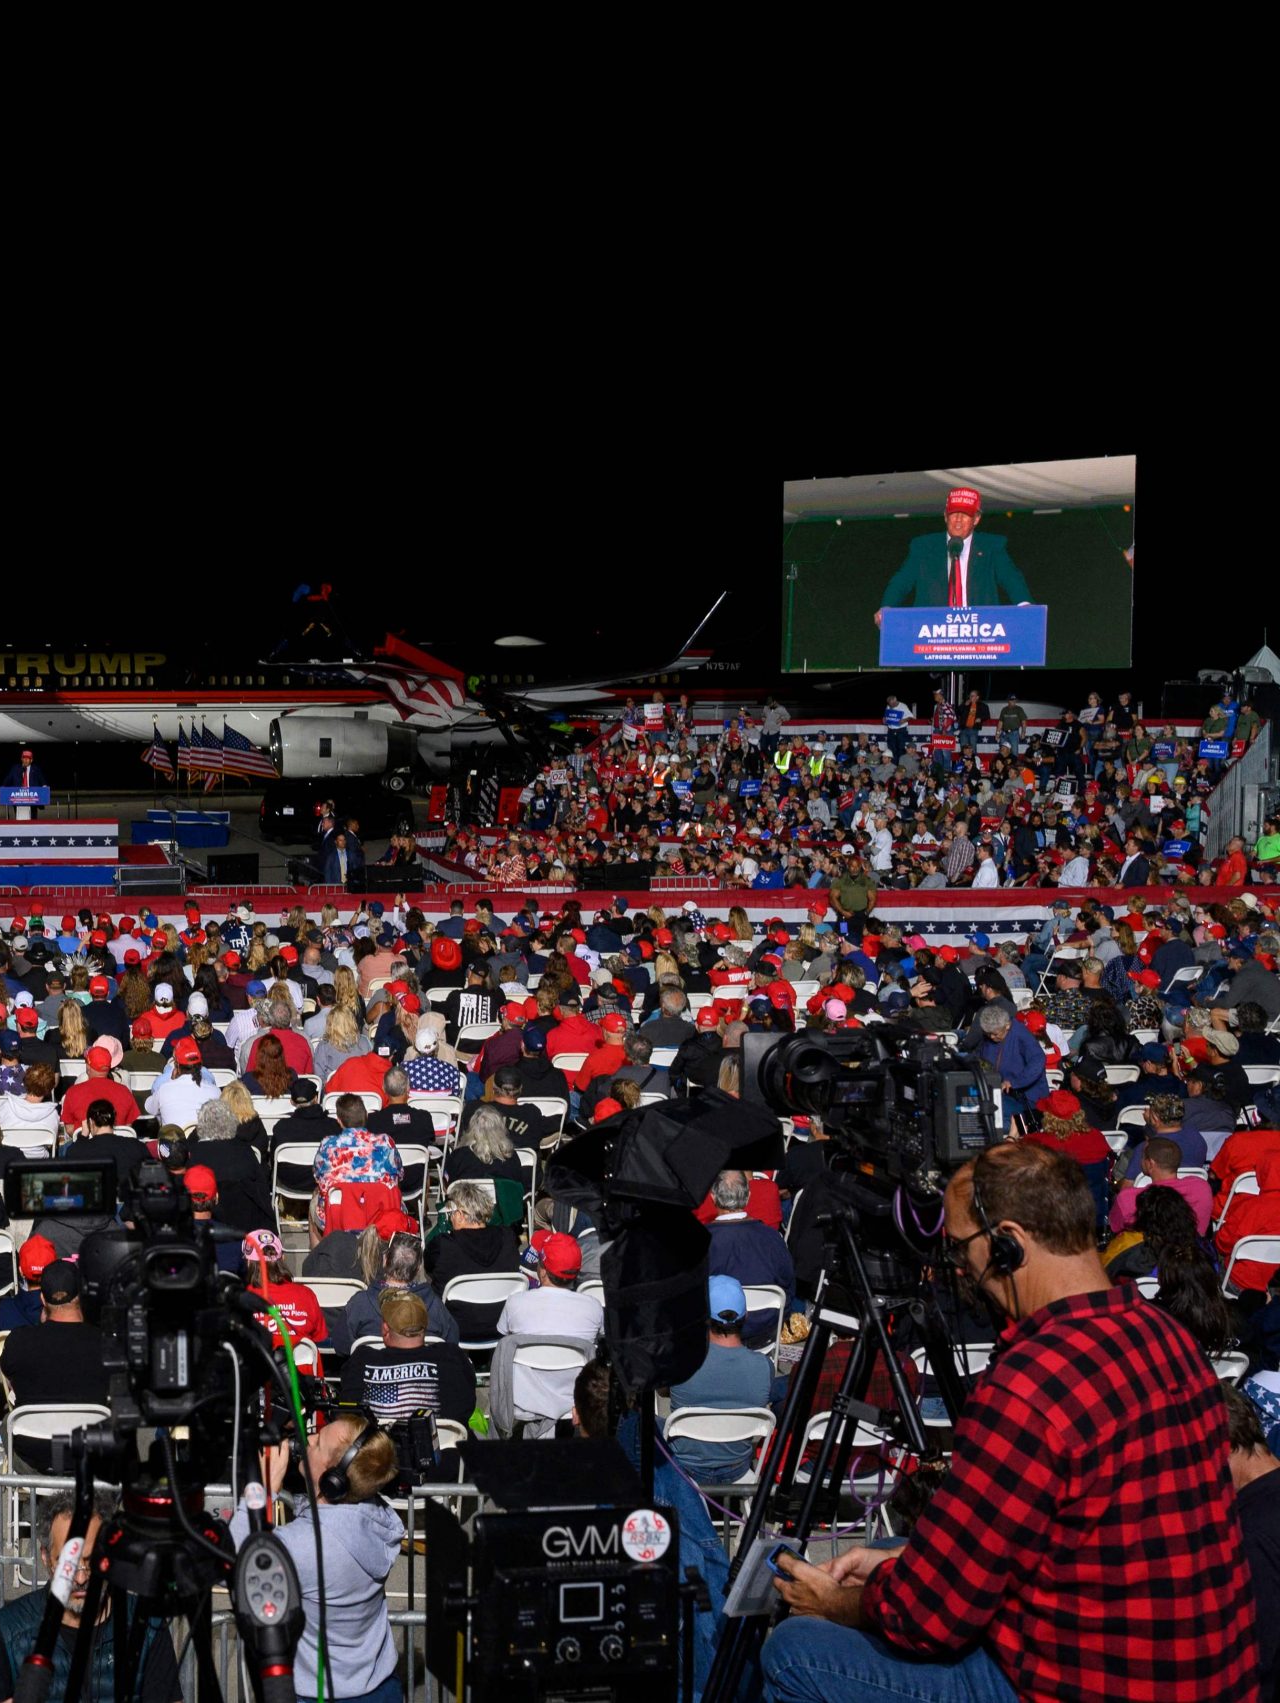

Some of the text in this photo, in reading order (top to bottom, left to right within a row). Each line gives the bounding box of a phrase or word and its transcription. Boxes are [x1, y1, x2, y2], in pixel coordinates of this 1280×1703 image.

[946, 614, 978, 624] SAVE
[918, 624, 1006, 638] AMERICA
[371, 1365, 430, 1381] AMERICA
[542, 1523, 618, 1558] GVM
[631, 1531, 661, 1543] RSBN
